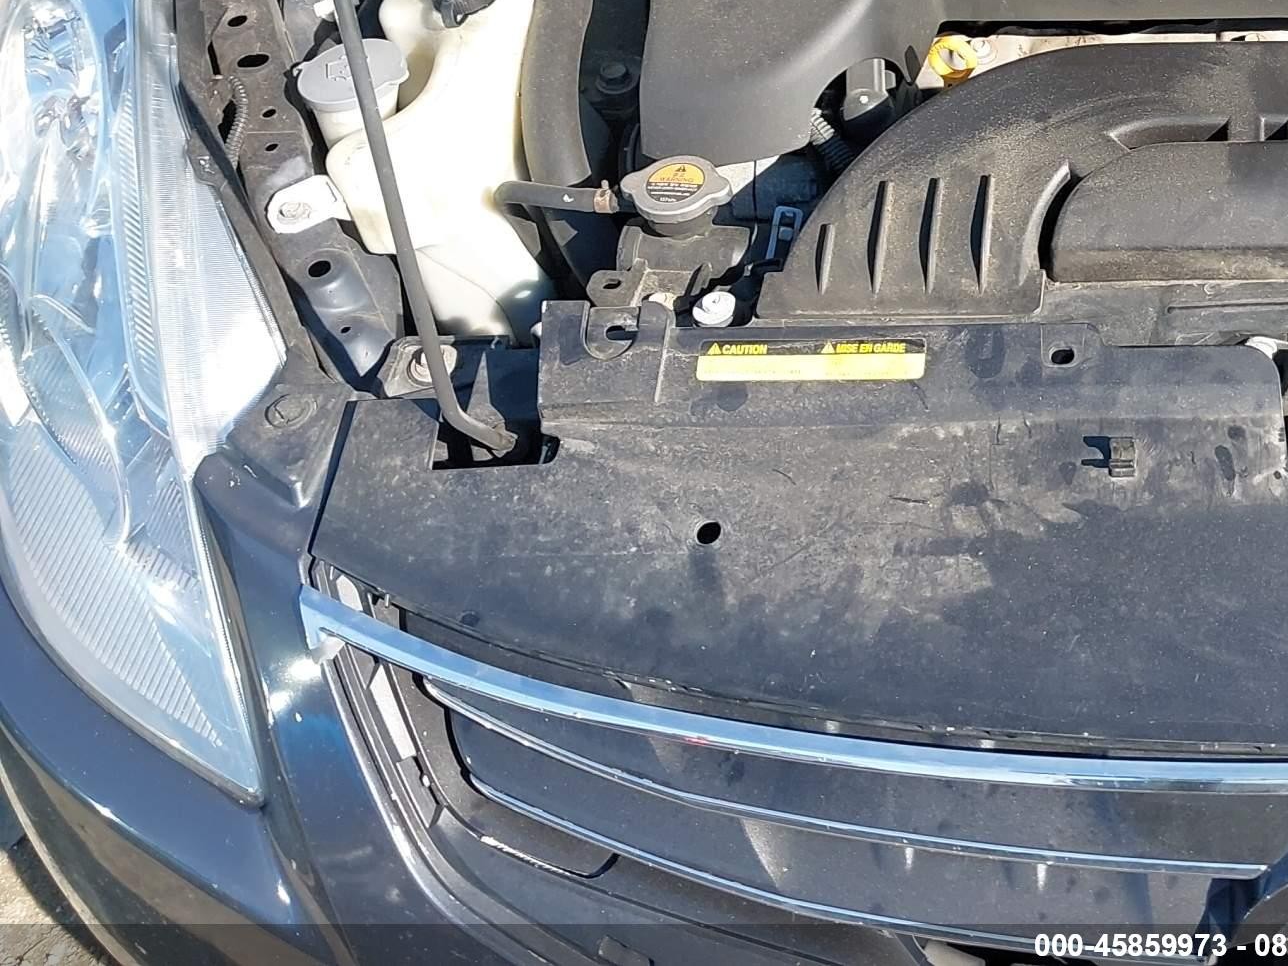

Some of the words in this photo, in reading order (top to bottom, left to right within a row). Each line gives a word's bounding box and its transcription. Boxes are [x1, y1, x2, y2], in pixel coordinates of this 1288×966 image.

[721, 344, 768, 355] CAUTION
[836, 343, 859, 354] MISE
[859, 343, 874, 353] EN
[873, 342, 907, 353] GARDE
